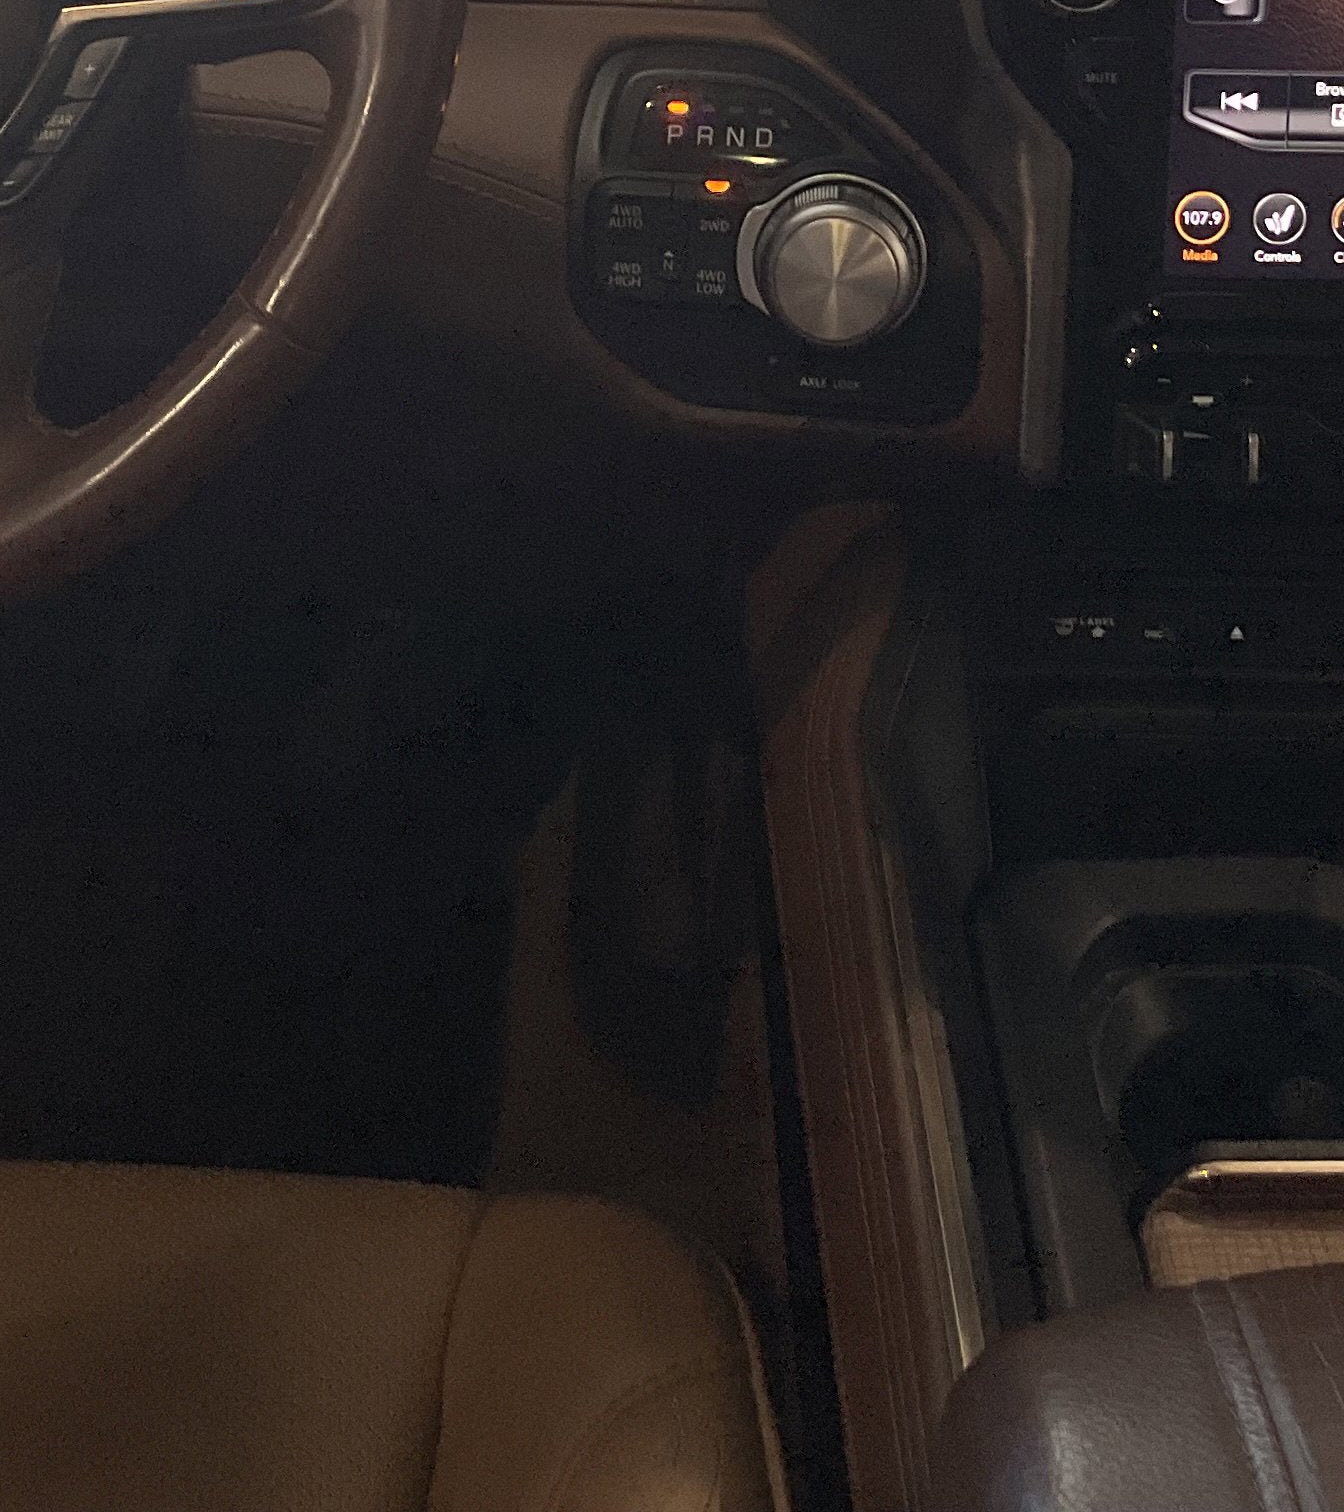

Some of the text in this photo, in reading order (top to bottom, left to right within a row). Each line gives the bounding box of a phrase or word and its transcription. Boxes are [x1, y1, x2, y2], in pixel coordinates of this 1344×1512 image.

[666, 125, 774, 149] P R N D
[1182, 209, 1224, 226] 107.9
[1182, 249, 1219, 263] Media
[1254, 250, 1302, 264] Controls
